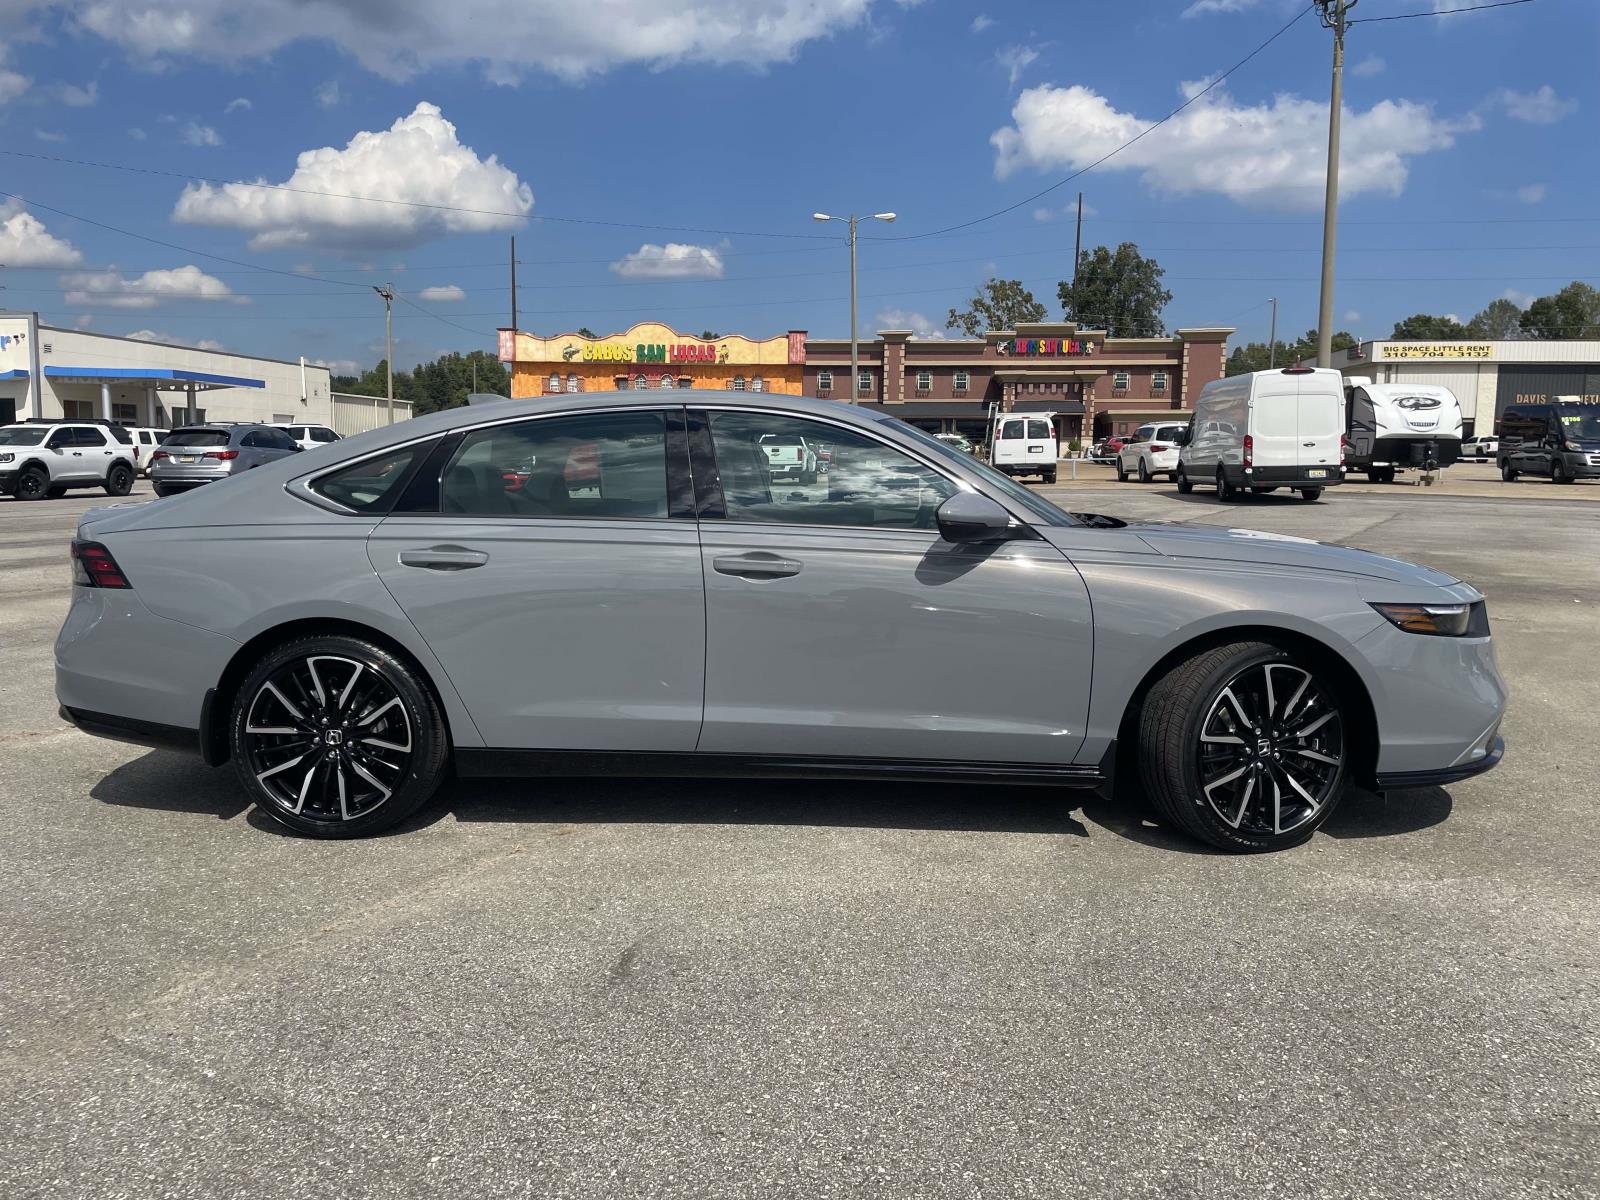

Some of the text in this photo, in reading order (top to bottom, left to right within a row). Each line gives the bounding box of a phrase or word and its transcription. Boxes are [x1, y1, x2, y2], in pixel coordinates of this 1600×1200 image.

[583, 343, 716, 361] CABOS SAN LUCAS
[1039, 339, 1057, 353] SAN
[1516, 394, 1547, 404] DAVIS
